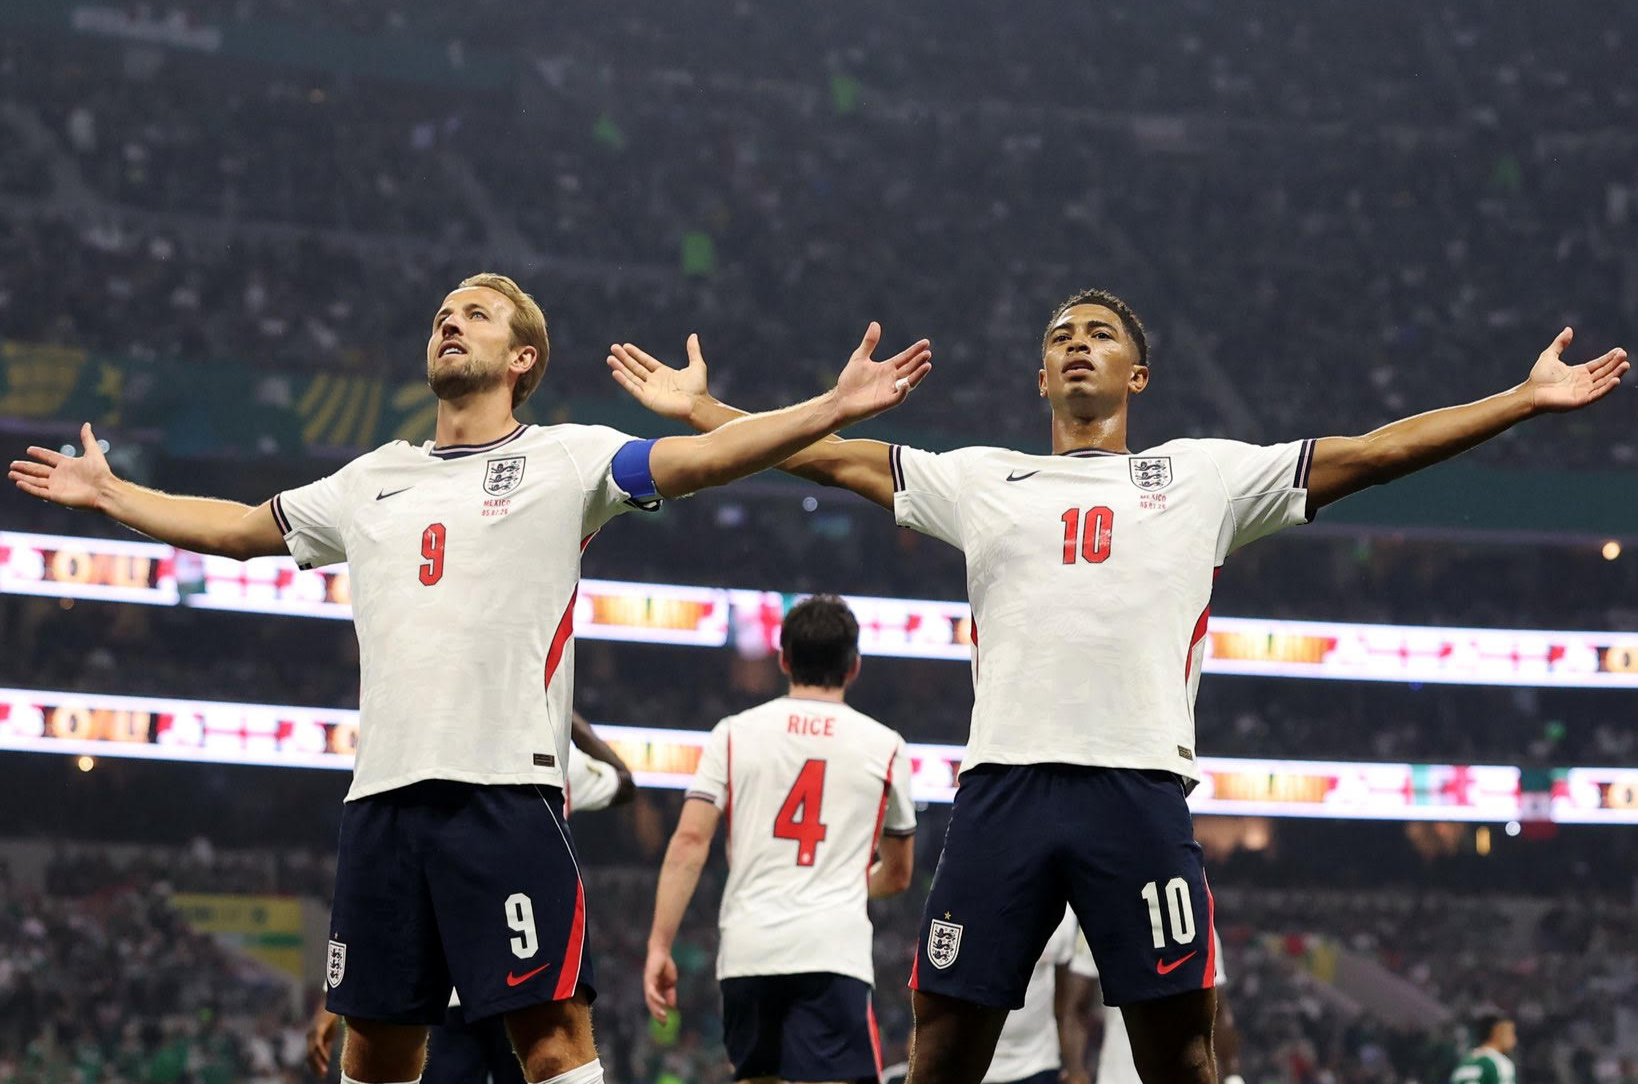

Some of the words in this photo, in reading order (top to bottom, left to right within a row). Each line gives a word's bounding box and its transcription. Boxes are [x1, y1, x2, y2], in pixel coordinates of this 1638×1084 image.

[483, 499, 511, 507] MEXICO
[1061, 506, 1114, 564] 10
[419, 522, 446, 586] 9
[787, 714, 836, 737] RICE
[773, 758, 827, 867] 4
[504, 892, 539, 960] 9
[1141, 877, 1196, 949] 10
